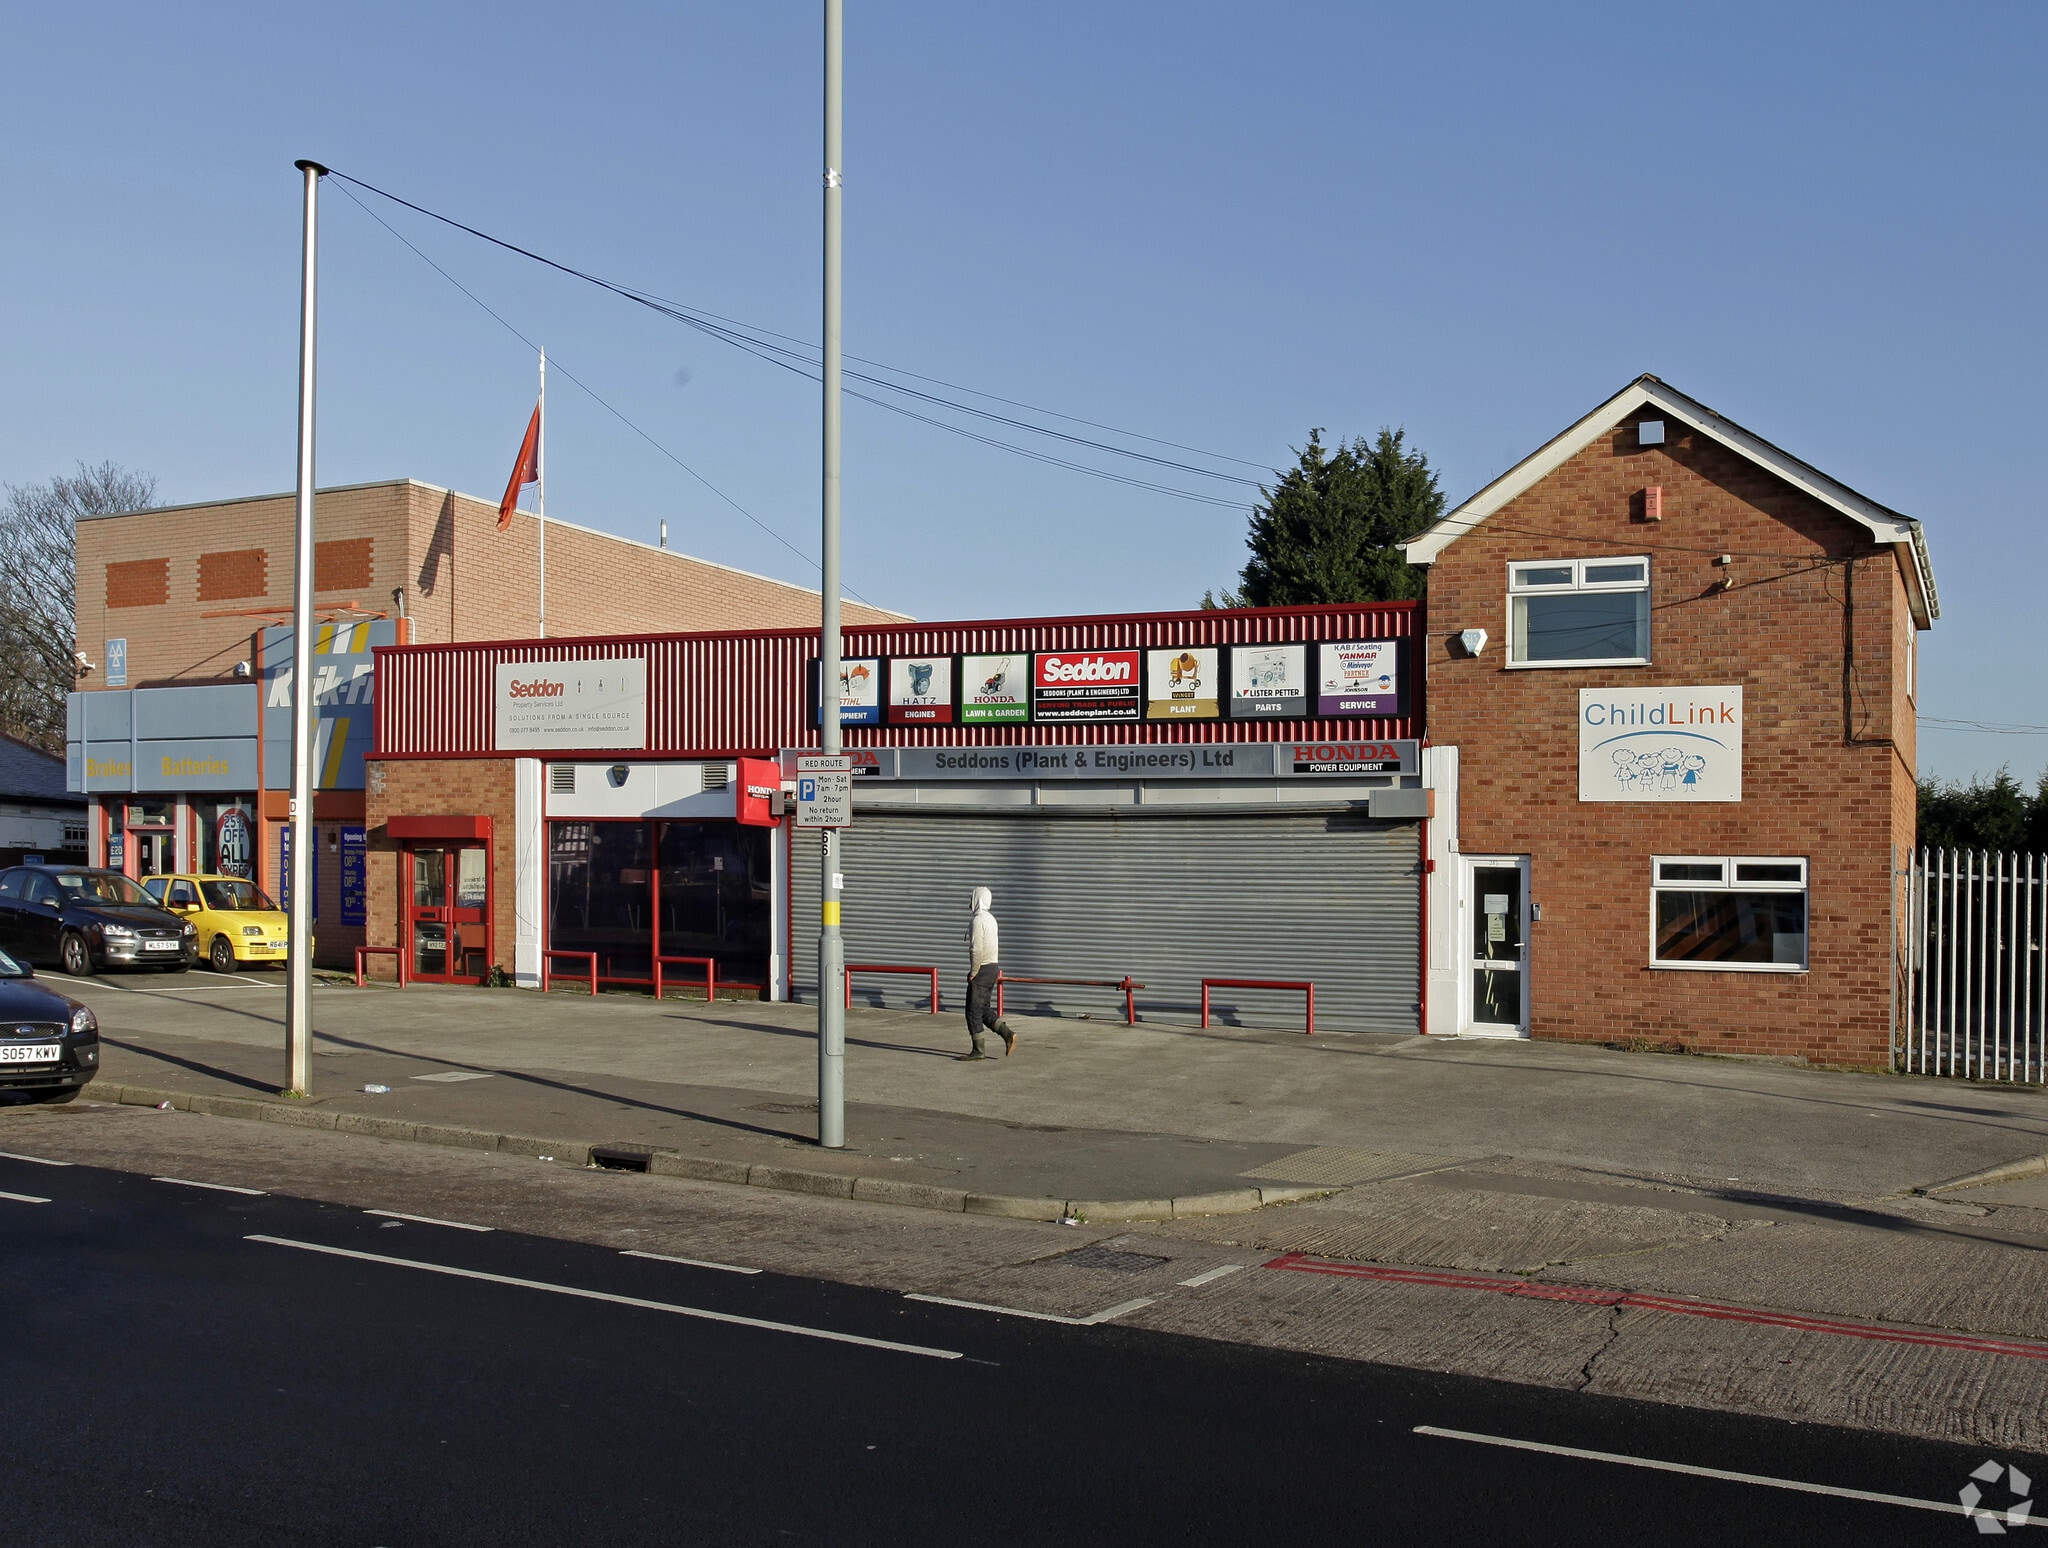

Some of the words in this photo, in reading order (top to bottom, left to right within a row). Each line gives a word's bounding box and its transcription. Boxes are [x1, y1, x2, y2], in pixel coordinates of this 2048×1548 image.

[1338, 652, 1377, 660] YANMAR
[1043, 657, 1130, 682] Seddon
[509, 679, 564, 698] Seddon
[1066, 689, 1085, 698] (PLANT
[1090, 688, 1120, 697] ENGINEERS)
[903, 697, 937, 705] HATZ
[973, 695, 1016, 704] HONDA
[513, 701, 532, 709] Property
[1170, 705, 1196, 713] PLANT
[1255, 704, 1282, 712] PARTS
[1339, 701, 1377, 709] SERVICE
[840, 712, 867, 720] UIPMENT
[995, 709, 1026, 717] GARDEN
[1037, 708, 1137, 717] www.seddonplant.co.uk
[1585, 701, 1735, 725] ChildLink
[1293, 744, 1400, 761] HONDA
[162, 755, 229, 776] Batteries
[936, 752, 1010, 769] Seddons
[1015, 751, 1068, 772] (Plant
[1074, 751, 1087, 768] &
[1094, 750, 1196, 771] Engineers)
[1203, 750, 1234, 766] Ltd
[86, 757, 131, 777] Brakes
[1339, 763, 1383, 771] EQUIPMENT
[747, 785, 776, 795] HOND
[802, 781, 813, 800] P
[804, 815, 823, 823] within
[223, 829, 244, 843] OFF
[344, 832, 362, 842] Opening
[221, 844, 248, 863] ALL
[221, 864, 249, 876] TYRES
[36, 1046, 57, 1059] KWV
